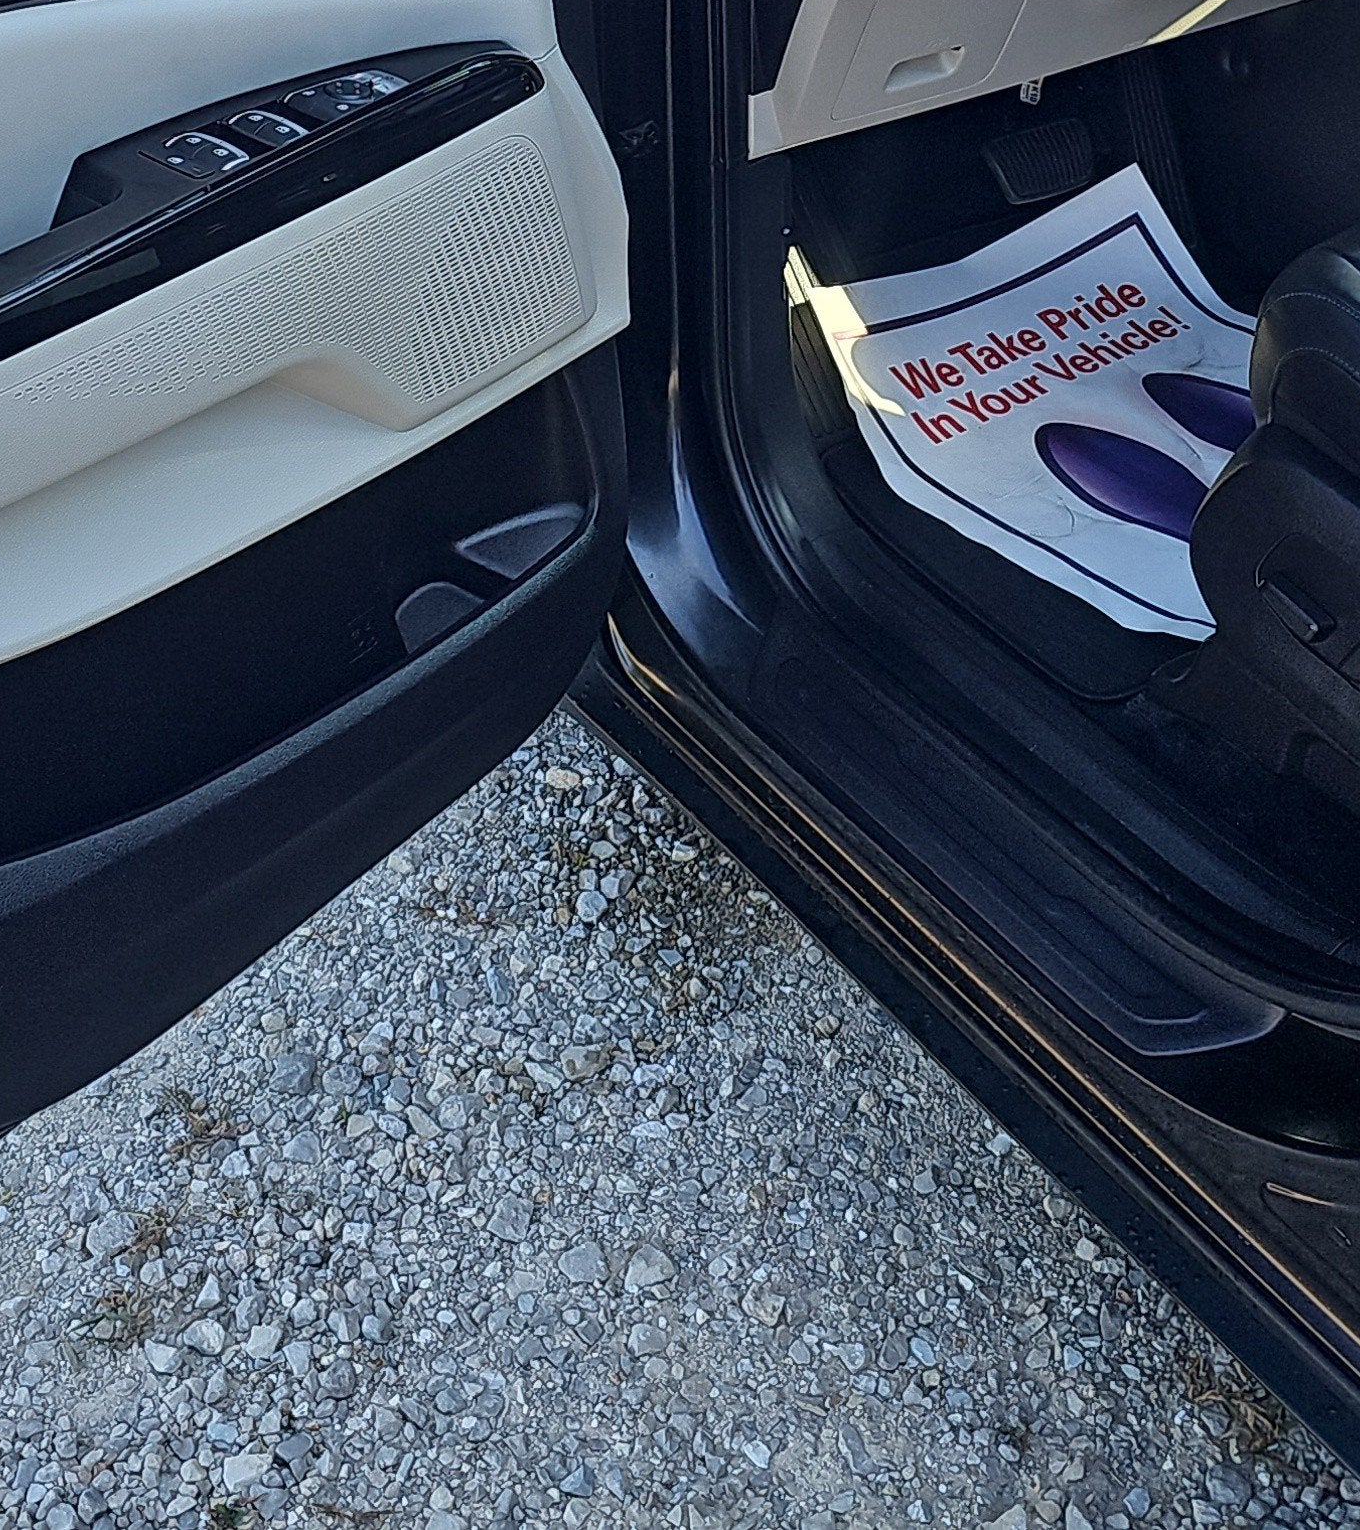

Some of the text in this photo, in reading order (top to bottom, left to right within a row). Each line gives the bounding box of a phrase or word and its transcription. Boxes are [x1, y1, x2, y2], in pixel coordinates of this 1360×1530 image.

[888, 282, 1147, 400] We Take Pride
[910, 305, 1192, 445] In Your Vehicle!
